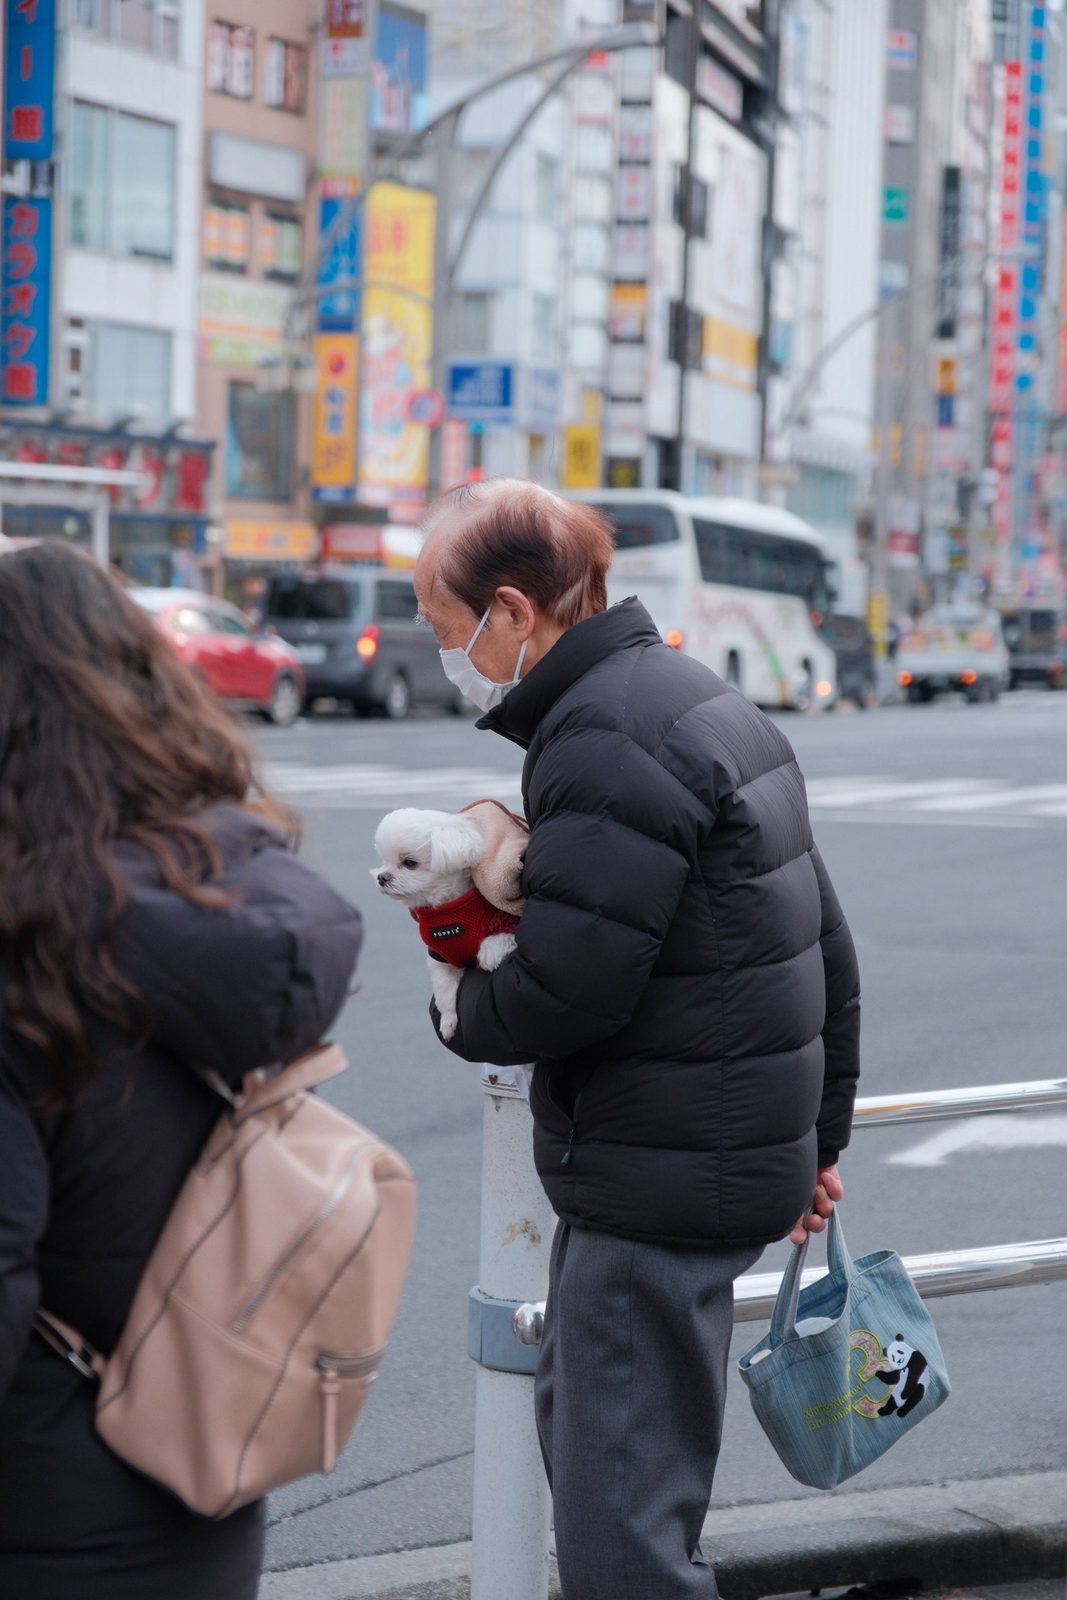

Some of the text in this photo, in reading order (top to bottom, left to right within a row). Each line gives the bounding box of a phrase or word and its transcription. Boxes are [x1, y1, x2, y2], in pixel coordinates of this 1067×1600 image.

[6, 203, 39, 398] カラオケ館
